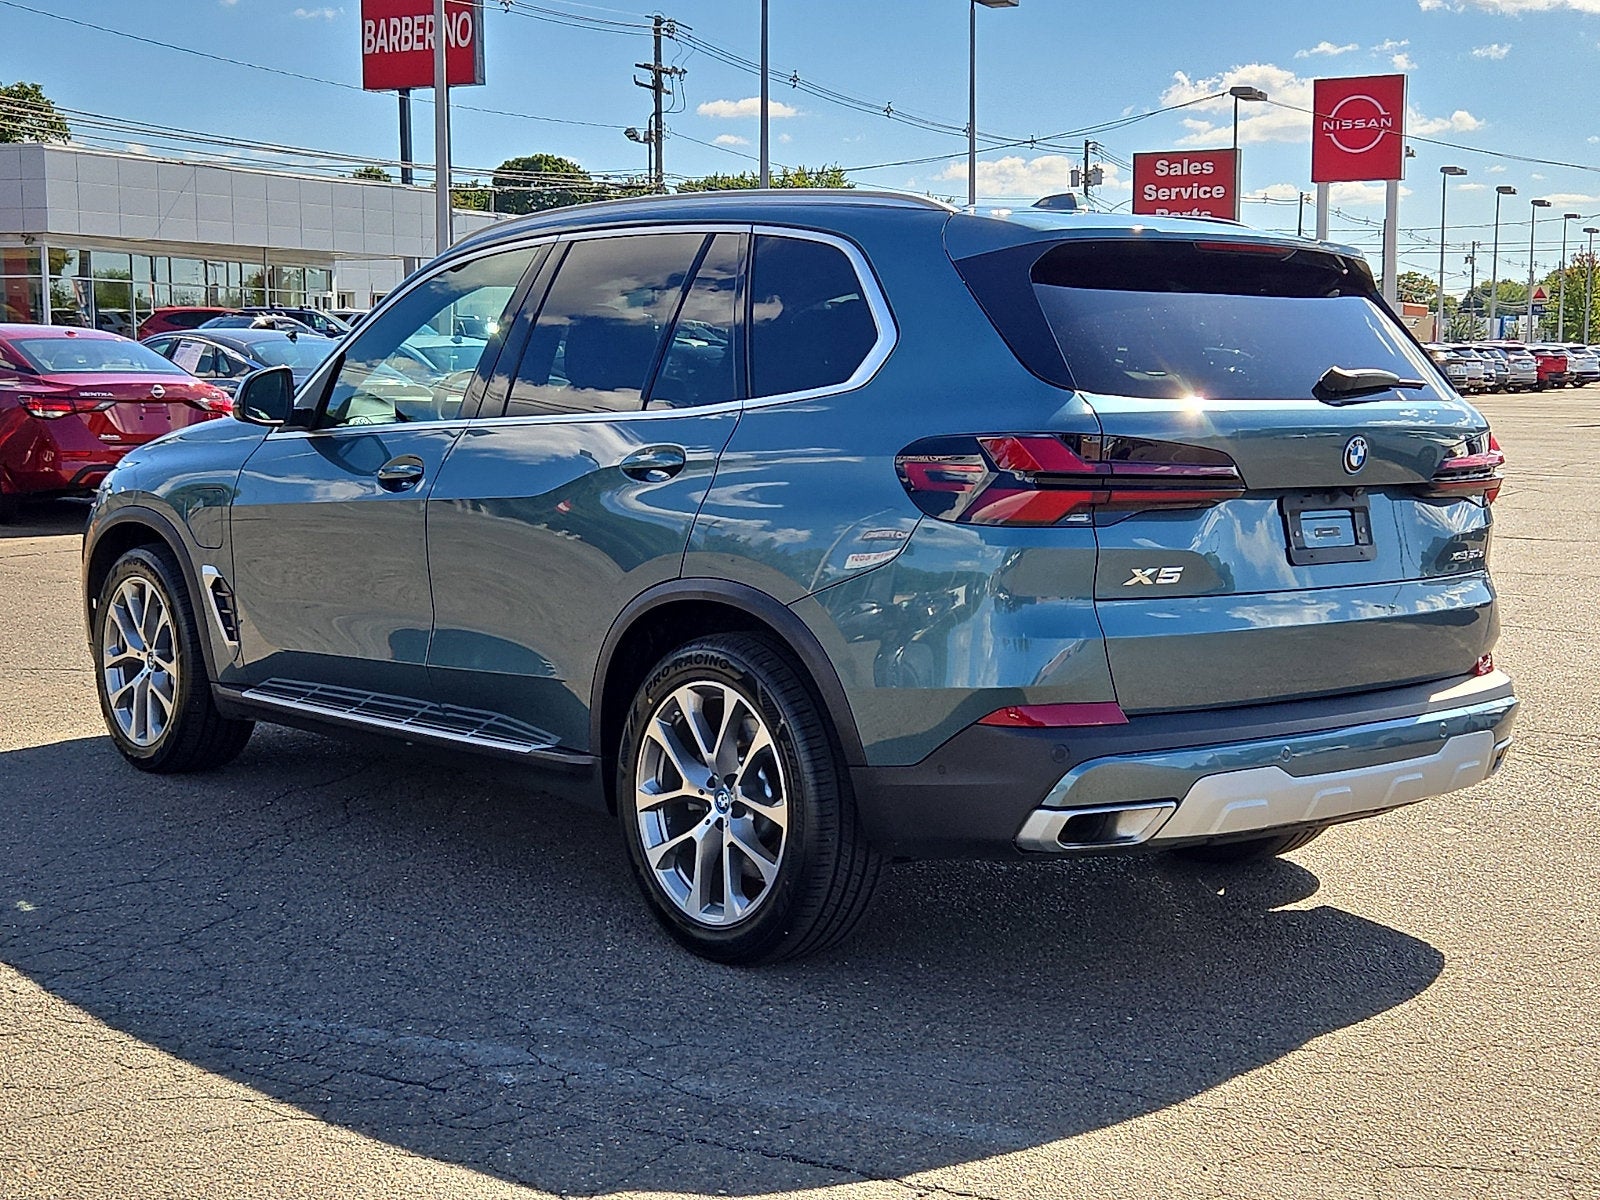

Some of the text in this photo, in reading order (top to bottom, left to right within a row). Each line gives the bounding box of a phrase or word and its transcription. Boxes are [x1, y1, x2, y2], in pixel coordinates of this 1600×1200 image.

[363, 11, 473, 55] BARBERNO
[1322, 117, 1392, 131] NISSAN
[1155, 158, 1214, 176] Sales
[1143, 182, 1226, 201] Service
[1122, 566, 1185, 586] X5
[645, 653, 731, 697] PRO RACING
